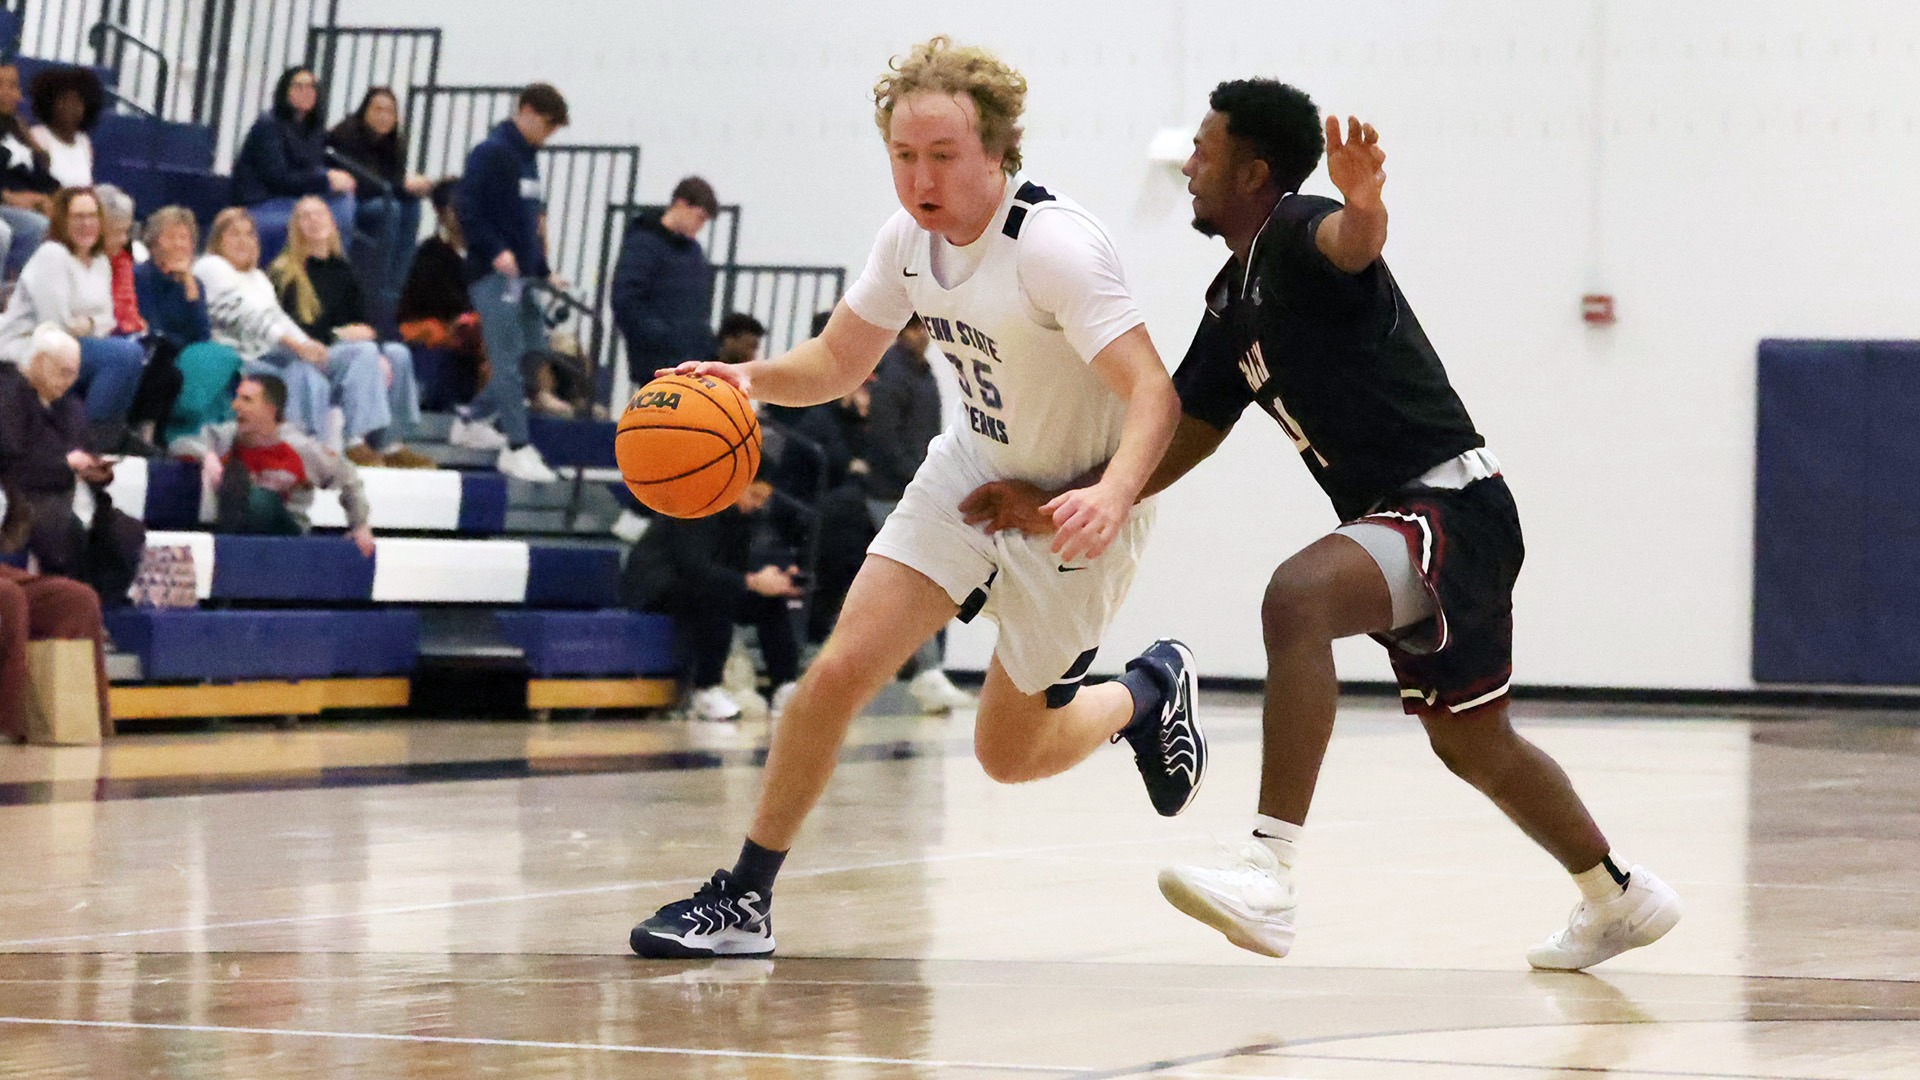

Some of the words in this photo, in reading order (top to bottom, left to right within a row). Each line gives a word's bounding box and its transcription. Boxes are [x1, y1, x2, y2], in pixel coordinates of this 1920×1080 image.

[920, 314, 955, 343] ENN
[956, 320, 1002, 363] STATE
[963, 401, 1009, 445] ERKS
